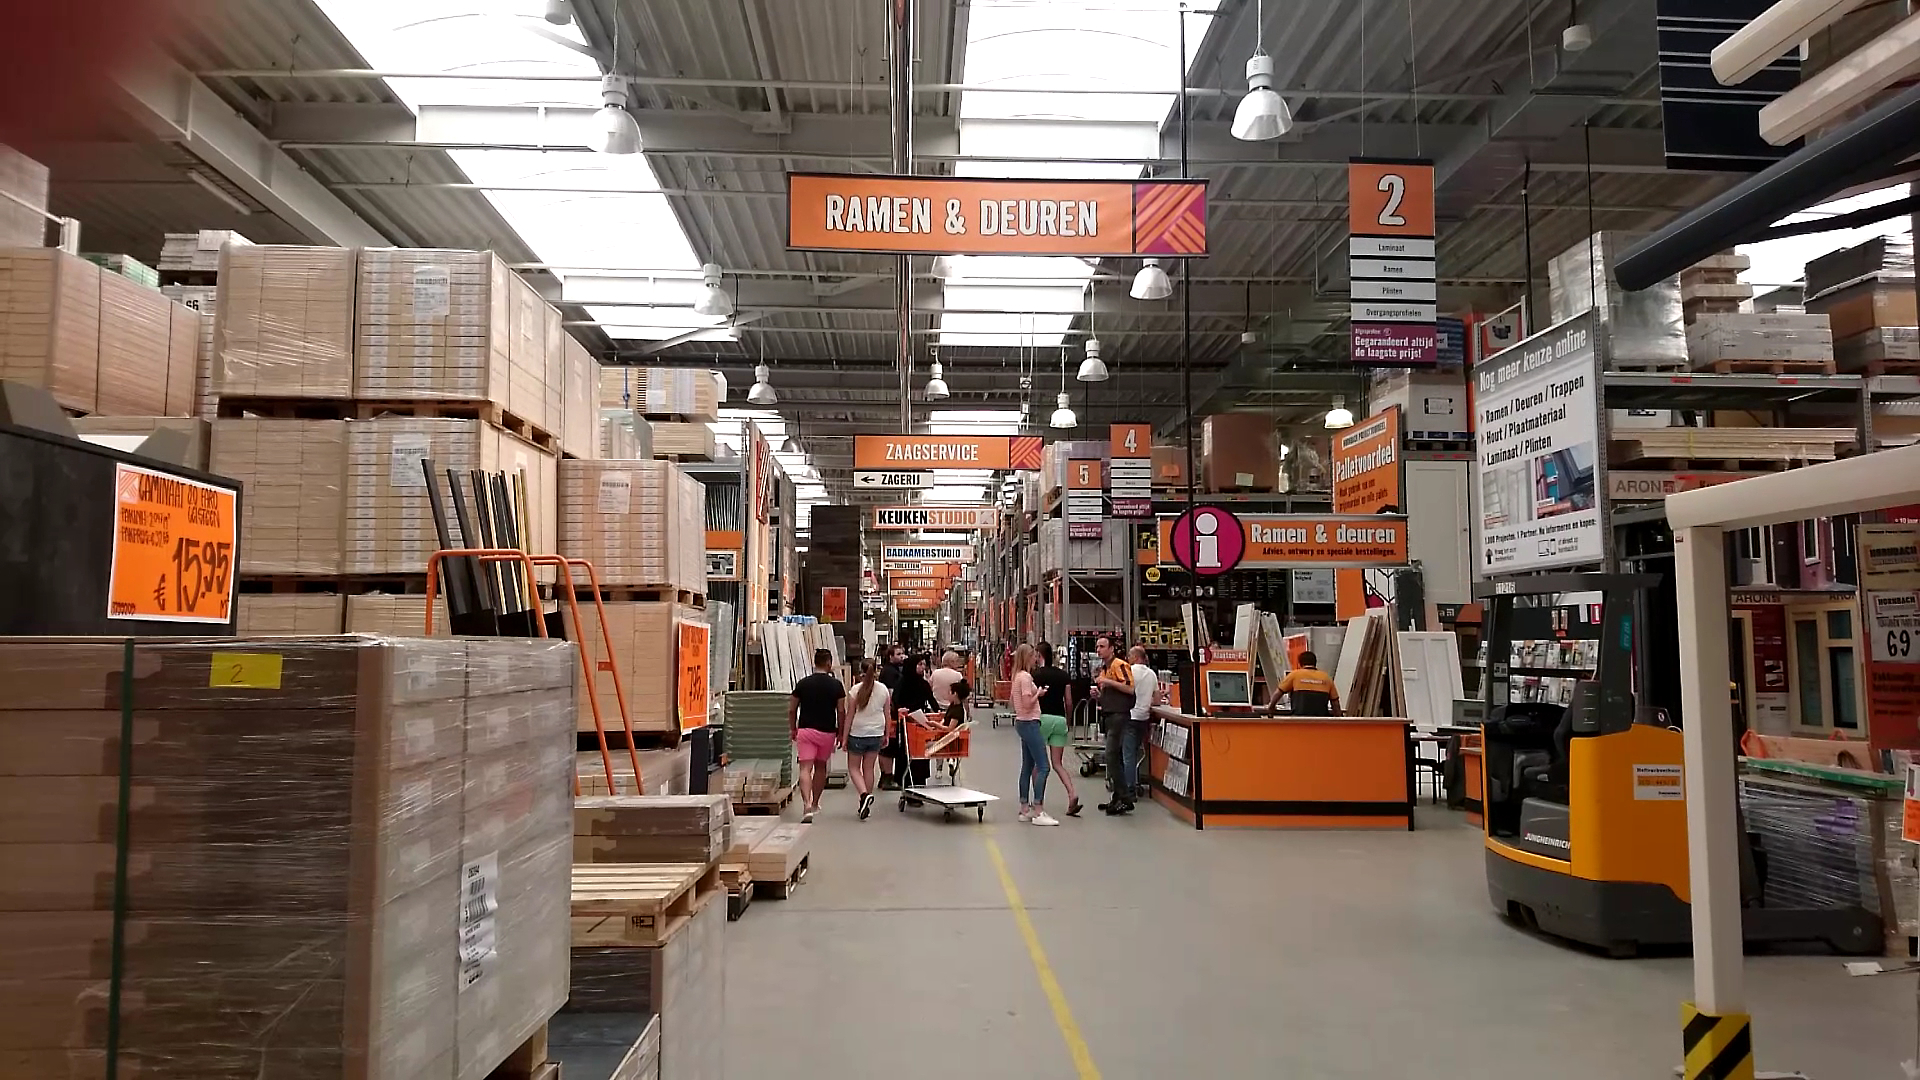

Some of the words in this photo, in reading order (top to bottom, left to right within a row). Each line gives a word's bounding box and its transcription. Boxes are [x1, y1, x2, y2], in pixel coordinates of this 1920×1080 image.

[1378, 173, 1406, 226] 2
[825, 194, 931, 234] RAMEN
[944, 198, 968, 236] &
[979, 200, 1099, 237] DEUREN
[1378, 244, 1405, 252] Laminaat
[1383, 265, 1403, 273] Ramen
[1382, 287, 1403, 296] Plinten
[1366, 308, 1422, 318] Overgangsprofielen
[1355, 336, 1409, 348] Gegarandeerd
[1411, 337, 1434, 349] altijd
[1355, 347, 1365, 357] de
[1367, 347, 1397, 359] laagste
[1400, 348, 1421, 359] prijs!
[1480, 371, 1495, 392] Nog
[1498, 360, 1520, 384] meer
[1523, 345, 1552, 373] keuze
[1555, 329, 1586, 358] online
[1485, 407, 1508, 424] Ramen
[1515, 392, 1543, 412] Deuren
[1550, 375, 1584, 398] Trappen
[1486, 429, 1502, 445] Hout
[1509, 403, 1566, 437] Plaatmateriaal
[1124, 429, 1138, 453] 4
[886, 443, 979, 461] ZAAGSERVICE
[1487, 444, 1519, 466] Laminaat
[1525, 435, 1552, 455] Plinten
[1335, 437, 1395, 483] Palletvoordeel
[881, 474, 920, 486] ZAGERIJ
[1078, 464, 1089, 485] 5
[1616, 480, 1660, 493] ARON
[878, 510, 977, 525] KEUKENSTUDIO
[1251, 523, 1307, 544] Ramen
[1315, 523, 1328, 544] &
[1336, 523, 1396, 544] deuren
[886, 549, 961, 558] BADKAMERSTUDIO
[1263, 547, 1286, 556] Advies,
[1287, 548, 1314, 557] ontwerp
[1327, 547, 1353, 557] speciale
[898, 579, 935, 587] VERLICHTING
[1878, 596, 1916, 606] HORNBACH
[1886, 629, 1910, 657] 69
[230, 663, 243, 684] 2
[1525, 831, 1571, 849] JUNGHEINRICH
